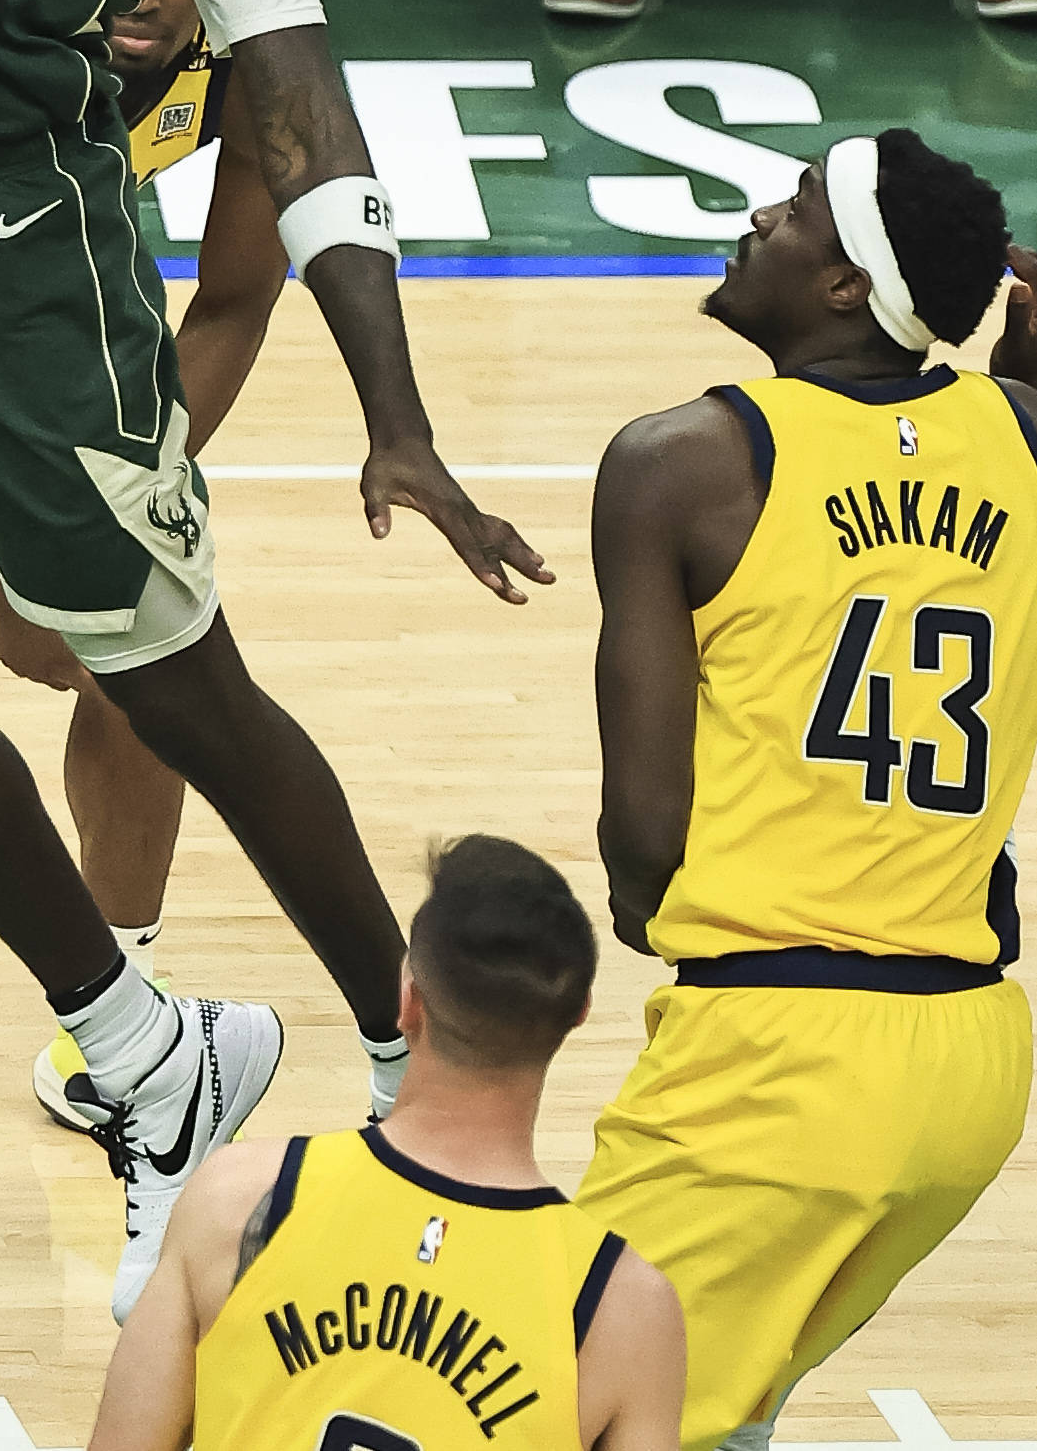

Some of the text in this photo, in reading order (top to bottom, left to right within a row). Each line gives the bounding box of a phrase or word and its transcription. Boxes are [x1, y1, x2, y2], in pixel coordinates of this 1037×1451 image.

[825, 480, 1009, 571] SIAKAM
[802, 593, 995, 819] 43
[264, 1281, 540, 1440] McCONNELL
